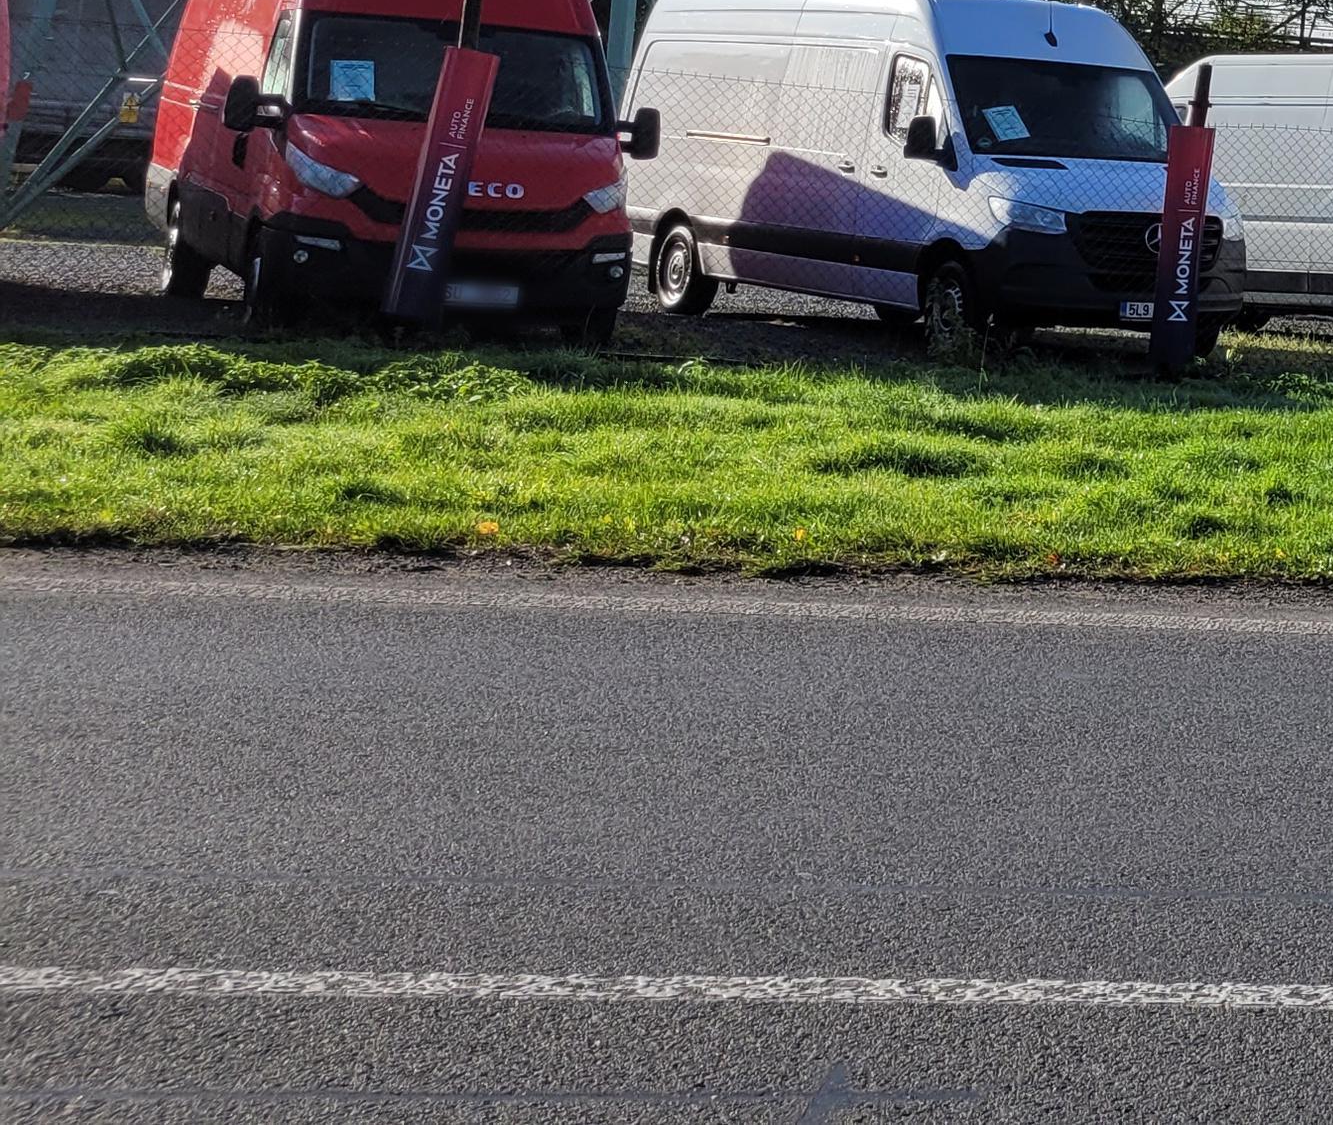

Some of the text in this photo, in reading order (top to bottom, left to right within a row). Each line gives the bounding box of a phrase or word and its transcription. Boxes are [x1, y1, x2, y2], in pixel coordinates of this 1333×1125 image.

[448, 111, 461, 138] AUTO
[457, 98, 474, 140] FINANCE
[421, 153, 460, 240] MONETA
[467, 181, 525, 199] ECO
[1183, 181, 1192, 205] AUTO
[1191, 169, 1200, 205] FINANCE
[1175, 217, 1196, 294] MONETA
